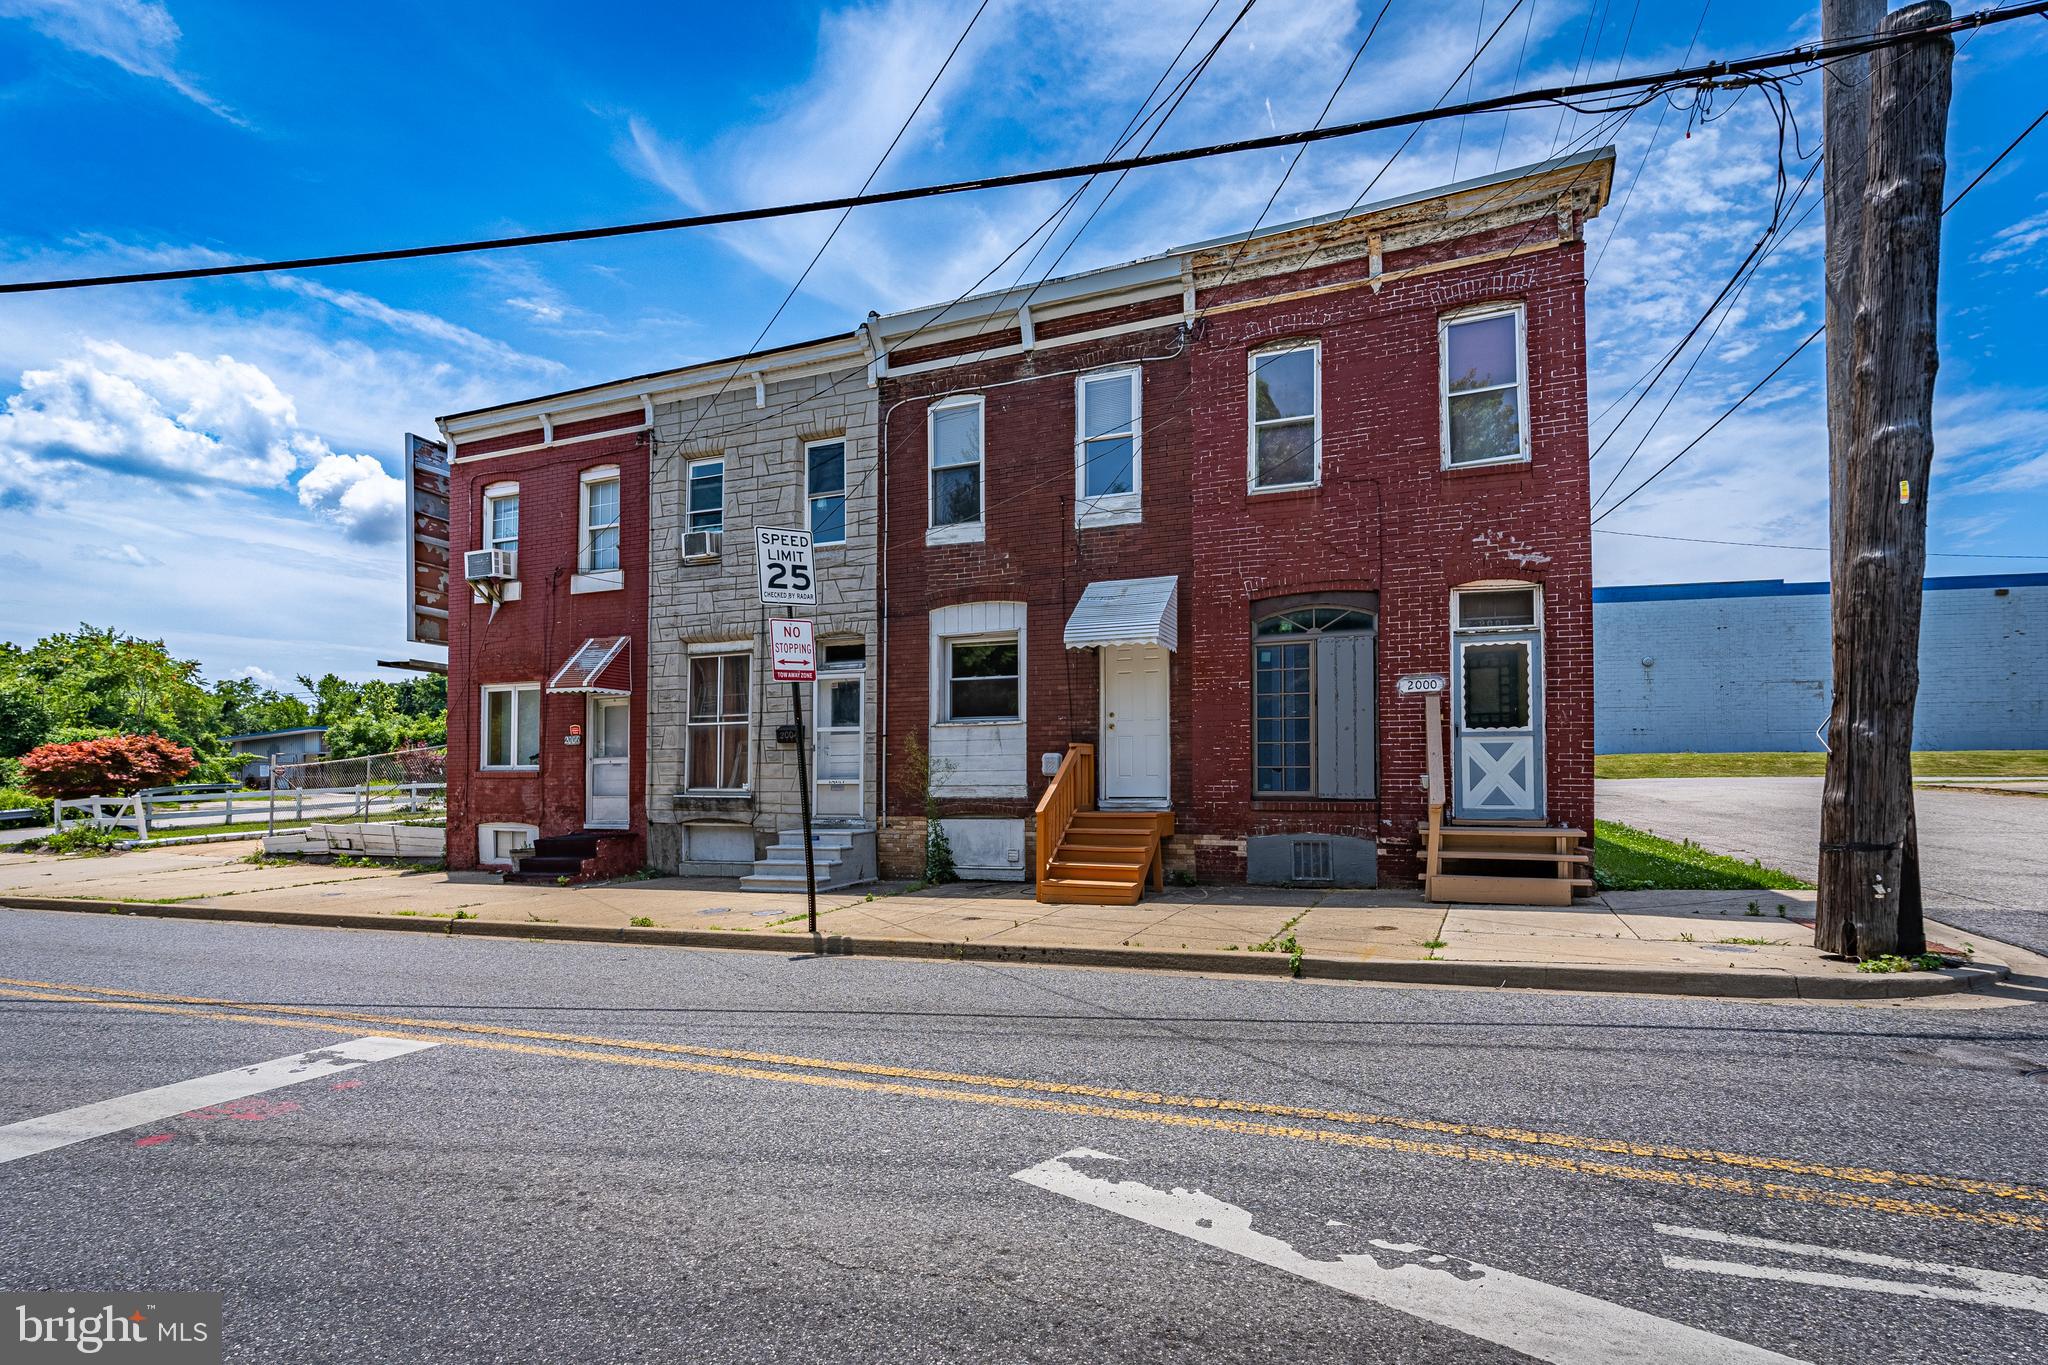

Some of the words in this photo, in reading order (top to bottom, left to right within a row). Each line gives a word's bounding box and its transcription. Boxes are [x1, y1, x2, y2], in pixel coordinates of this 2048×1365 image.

[761, 532, 809, 548] SPEED
[767, 548, 804, 562] LIMIT
[766, 562, 811, 590] 25
[763, 591, 787, 599] CHECKED
[783, 626, 801, 638] NO
[774, 642, 812, 655] STOPPING
[1407, 679, 1438, 691] 2000
